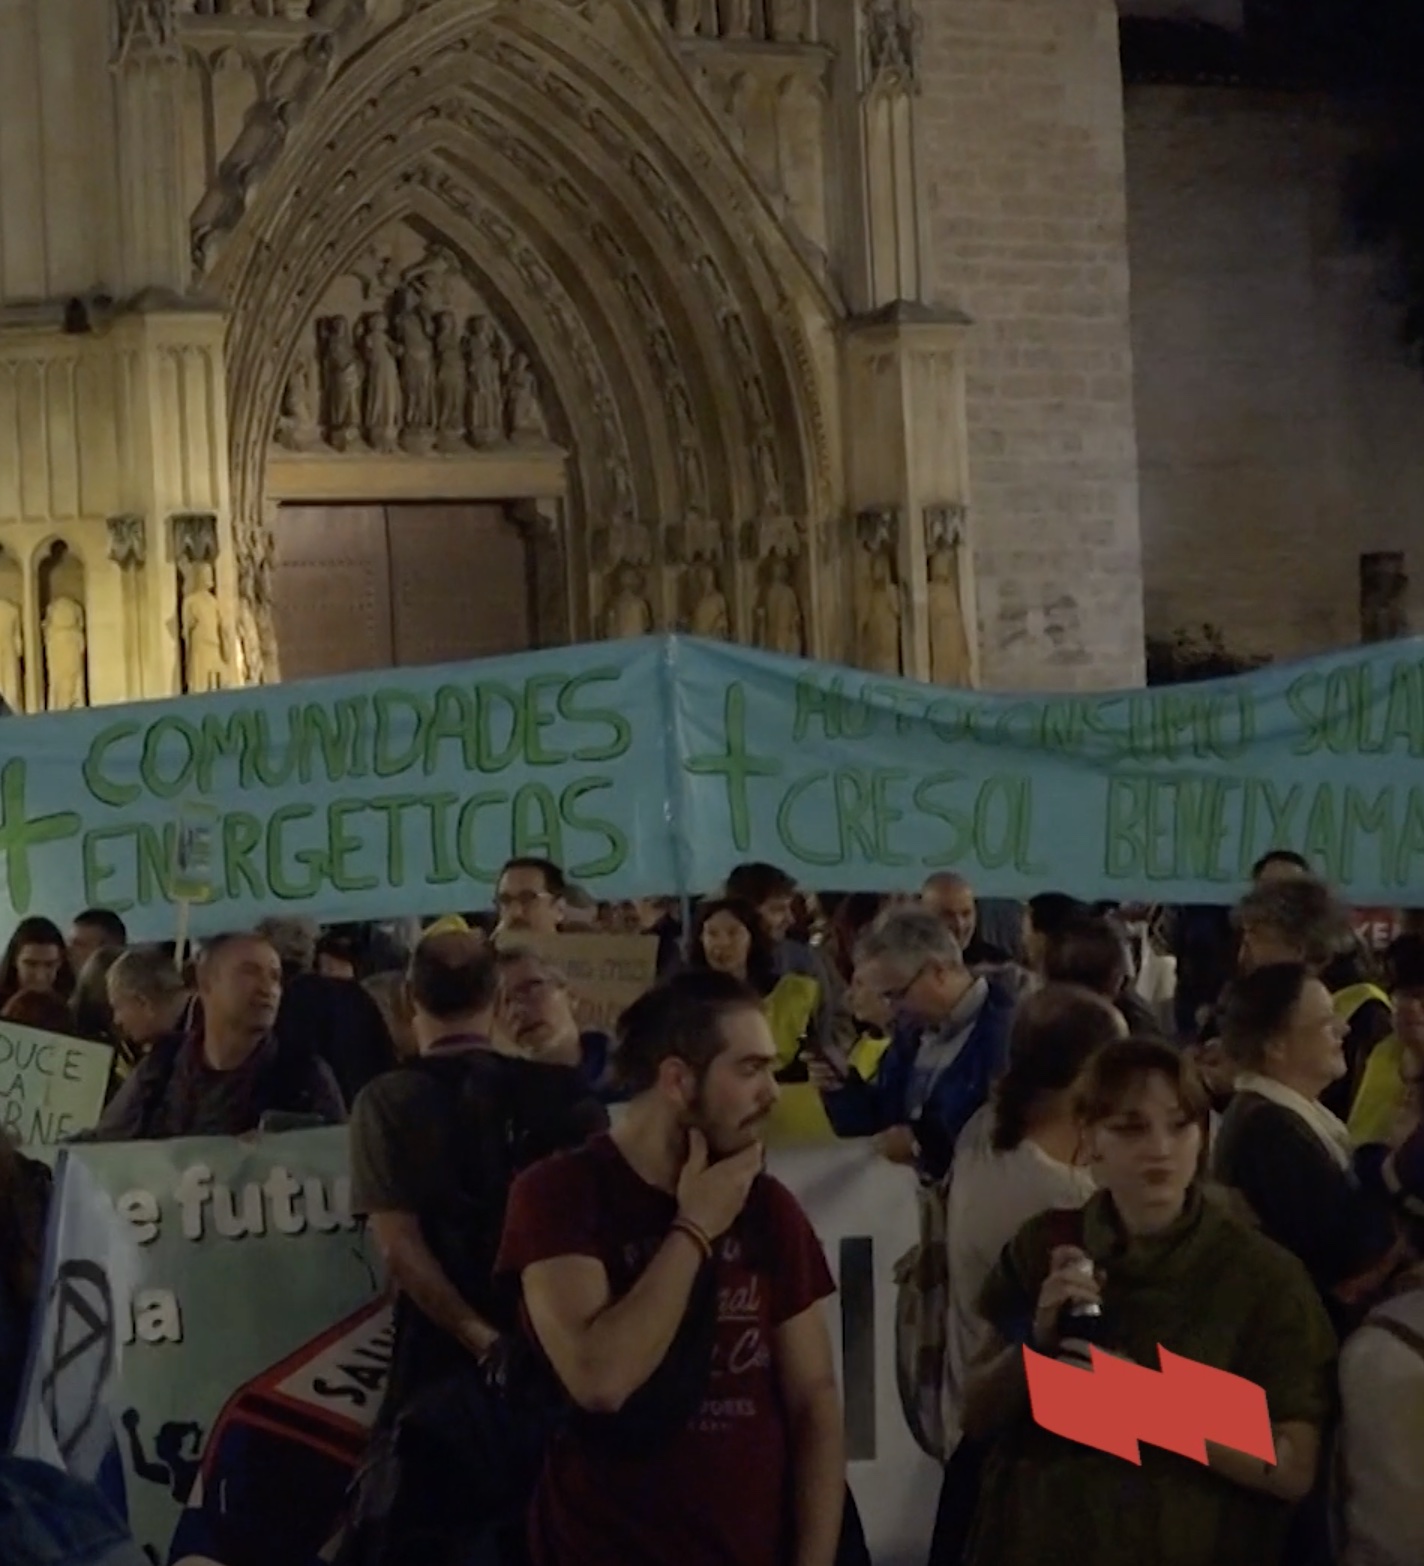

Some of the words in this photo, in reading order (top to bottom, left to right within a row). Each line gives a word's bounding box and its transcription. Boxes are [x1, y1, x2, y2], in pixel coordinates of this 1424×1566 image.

[81, 669, 633, 807] COMUNIDADES
[1285, 658, 1424, 758] SOLA
[82, 775, 629, 913] ENRGETICAS
[5, 1100, 74, 1146] RNE
[173, 1162, 359, 1242] futu
